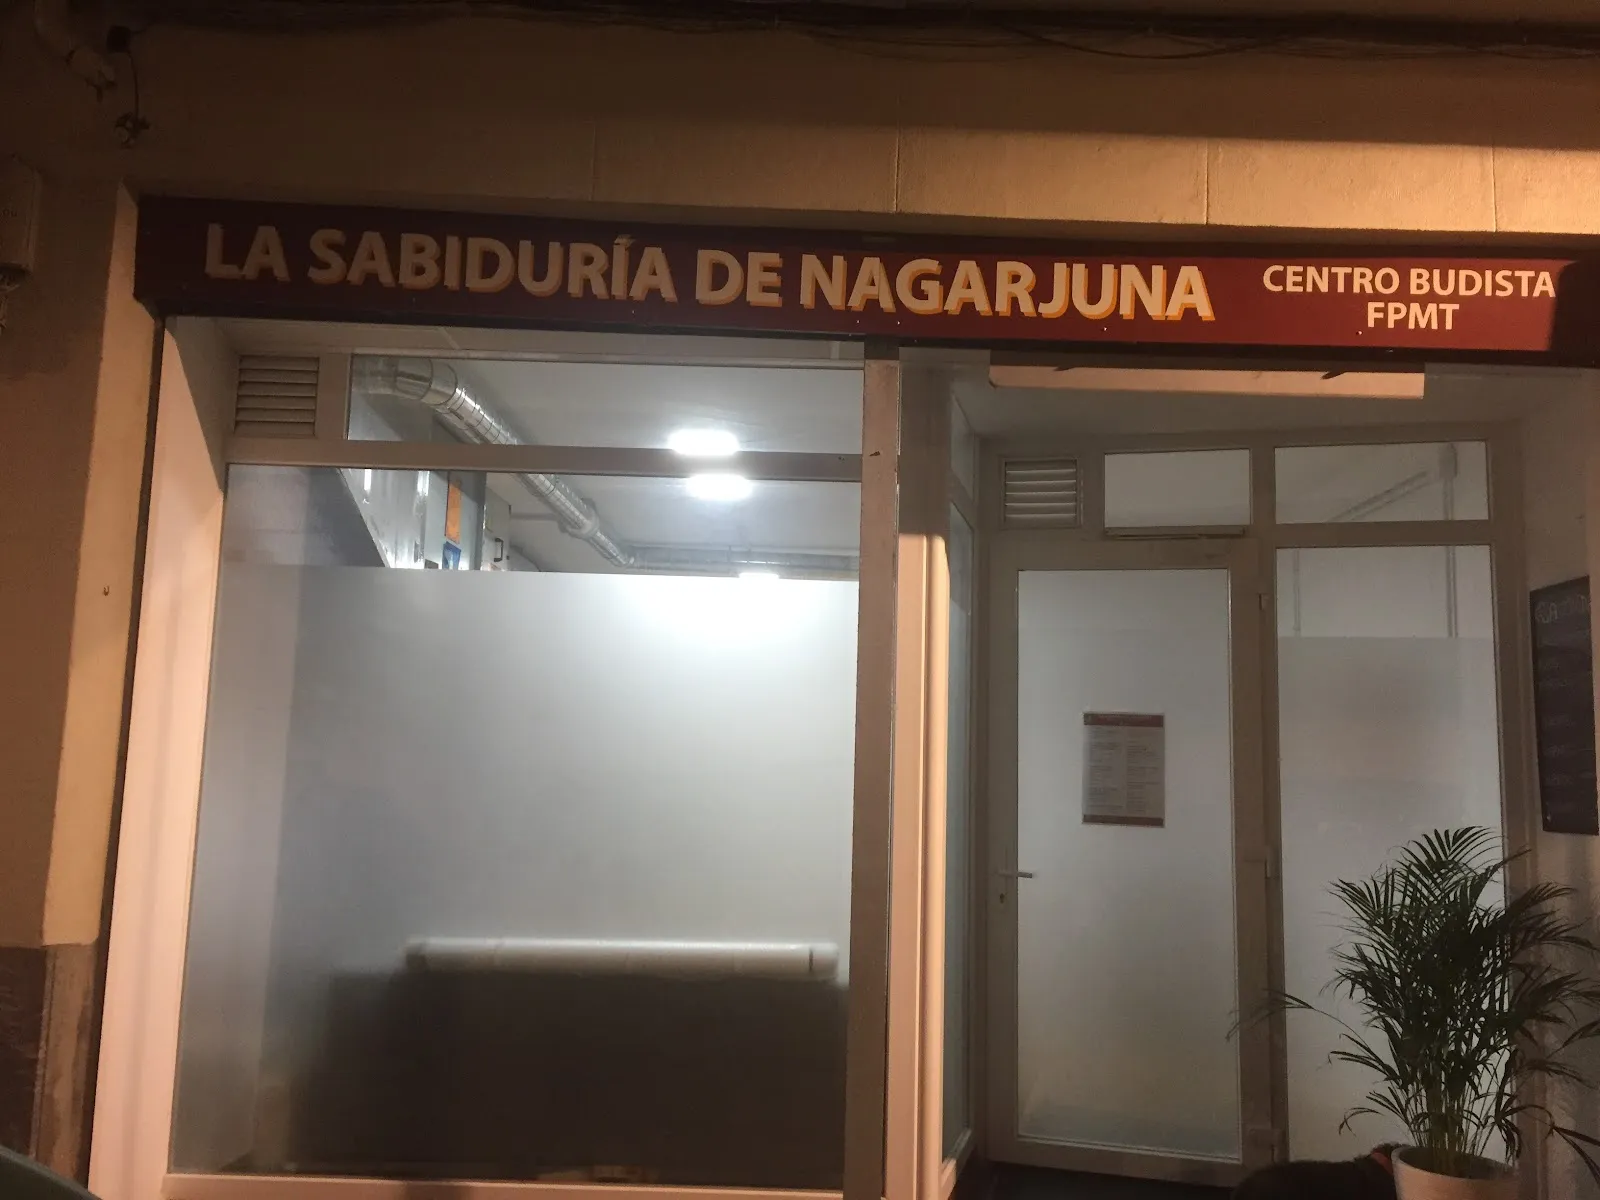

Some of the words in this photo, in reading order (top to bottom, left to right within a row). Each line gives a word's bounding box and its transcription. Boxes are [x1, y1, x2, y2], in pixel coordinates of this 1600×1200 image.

[205, 223, 291, 282] LA
[308, 229, 678, 302] SABIDURÍA
[695, 249, 783, 308] DE
[799, 253, 1216, 321] NAGARJUNA
[1262, 265, 1400, 294] CENTRO
[1409, 268, 1556, 298] BUDISTA
[1367, 302, 1460, 330] FPMT
